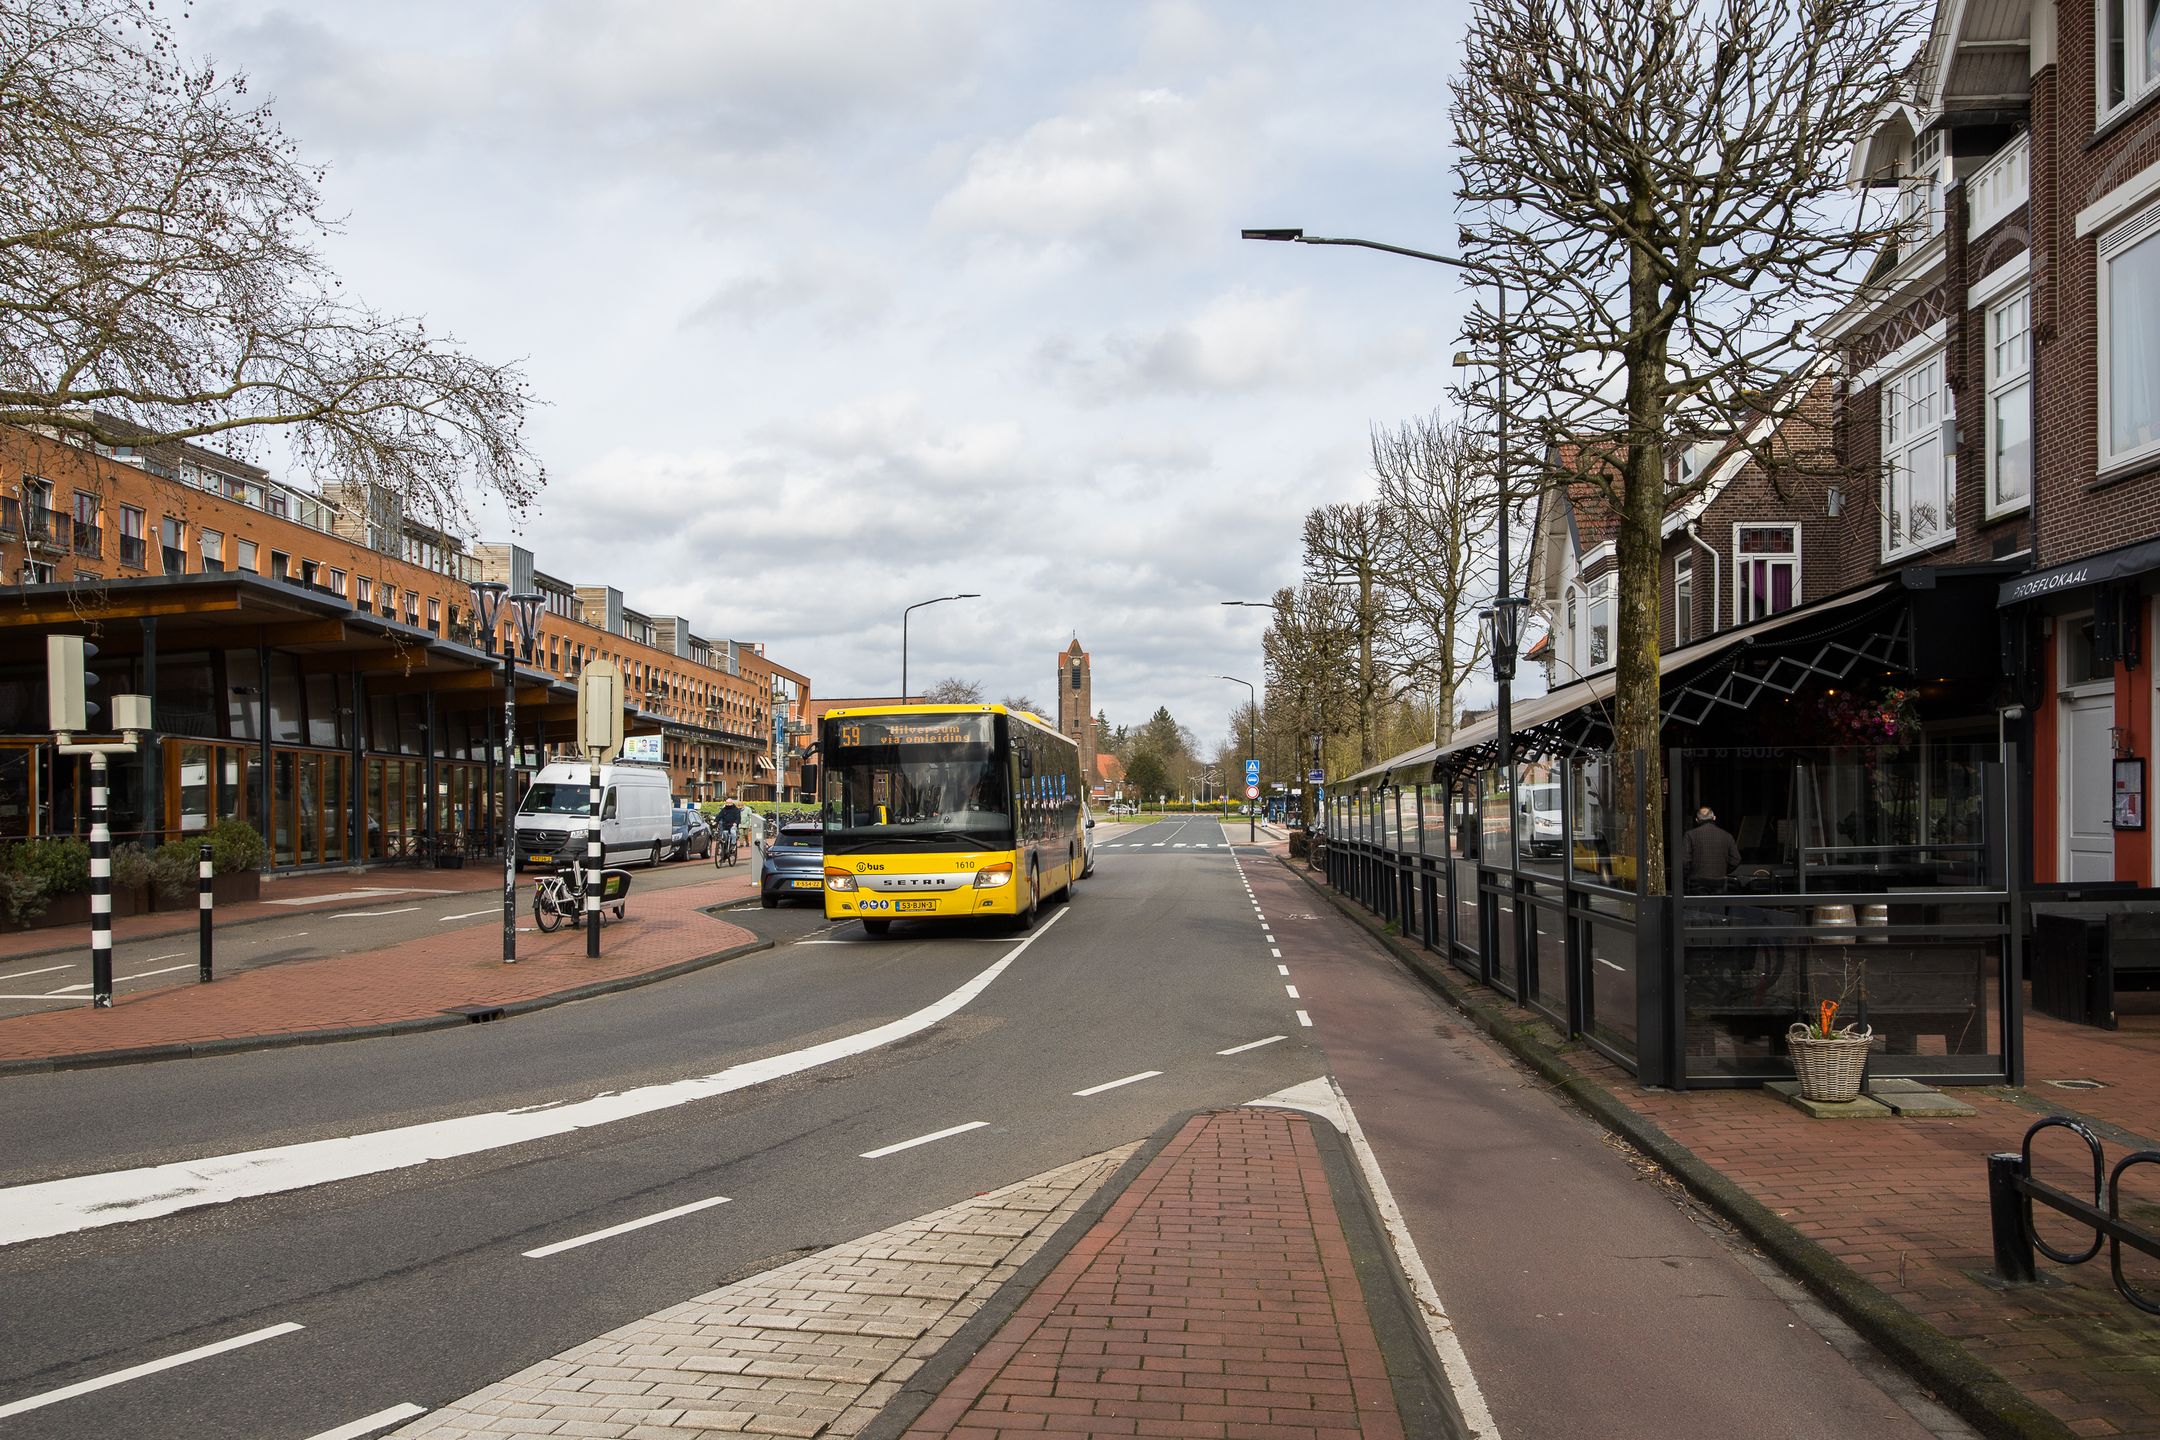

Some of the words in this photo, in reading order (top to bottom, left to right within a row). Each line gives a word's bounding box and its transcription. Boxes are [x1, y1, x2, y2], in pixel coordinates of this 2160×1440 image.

[2012, 568, 2088, 598] PROEFLOKAAL
[890, 725, 960, 735] Hilversum
[842, 726, 861, 746] 59
[881, 735, 900, 744] via
[906, 734, 970, 744] omleiding
[867, 863, 884, 871] bus
[955, 861, 975, 869] 1610
